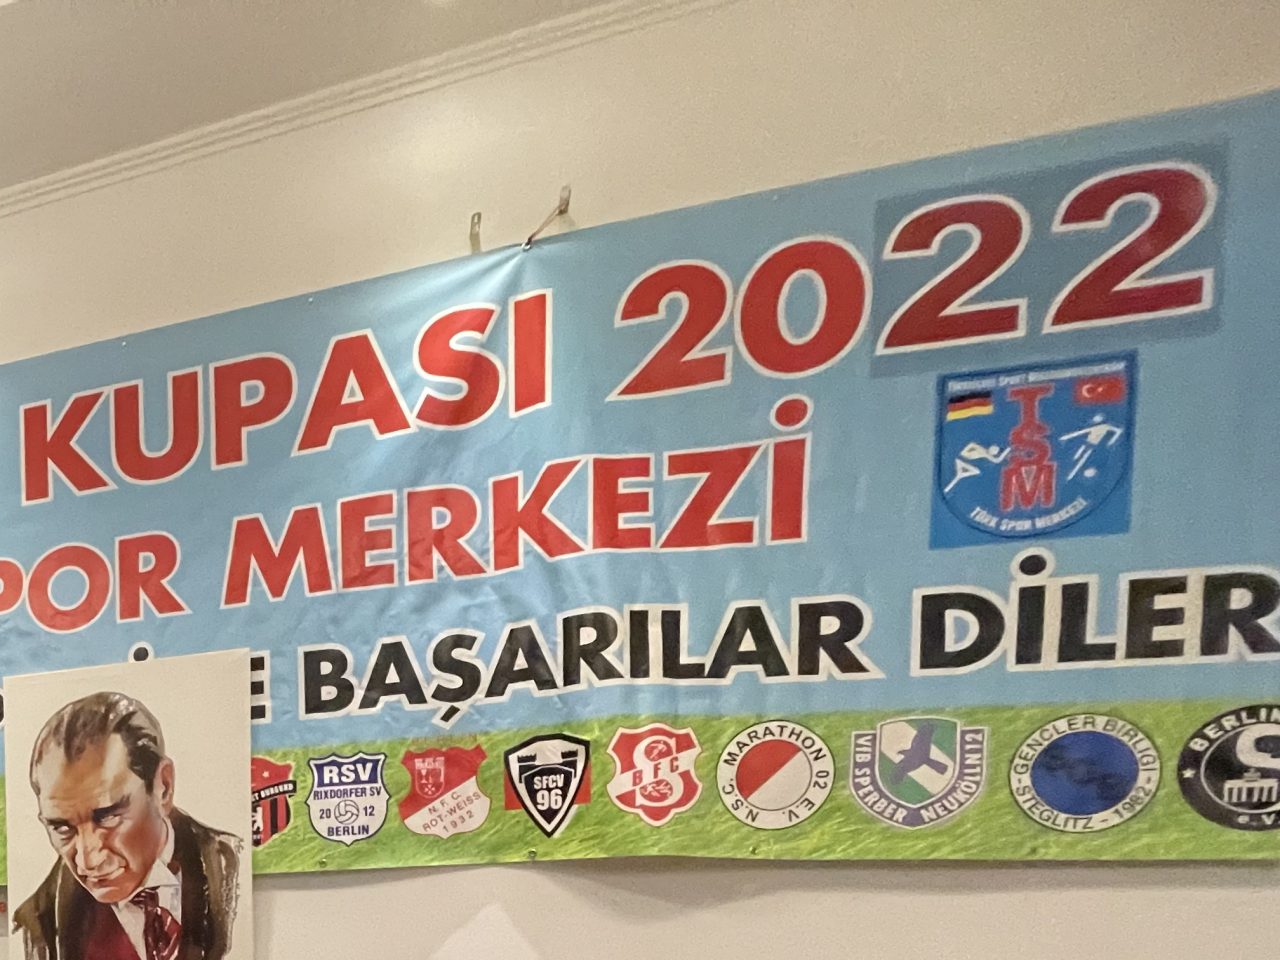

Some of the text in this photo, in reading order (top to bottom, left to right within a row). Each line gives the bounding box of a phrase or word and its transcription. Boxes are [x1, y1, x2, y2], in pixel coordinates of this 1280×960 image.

[21, 289, 552, 504] KUPASI
[607, 161, 1216, 401] 2022
[220, 394, 813, 608] MERKEZİ
[300, 601, 876, 723] BAŞARILAR
[917, 555, 1280, 671] DİLER
[322, 762, 373, 785] RSV
[723, 724, 827, 767] MARATHON
[812, 769, 830, 790] 02
[313, 786, 382, 801] RIXDORFER SV
[533, 773, 565, 790] SFCV
[536, 788, 563, 811] 96
[853, 767, 908, 823] SPERBER
[920, 753, 982, 823] NEUKÖLLN
[319, 805, 375, 820] 20 12
[422, 791, 482, 833] ROT-WEISS
[1014, 784, 1095, 830] STEGLITZ
[327, 824, 370, 837] BERLIN
